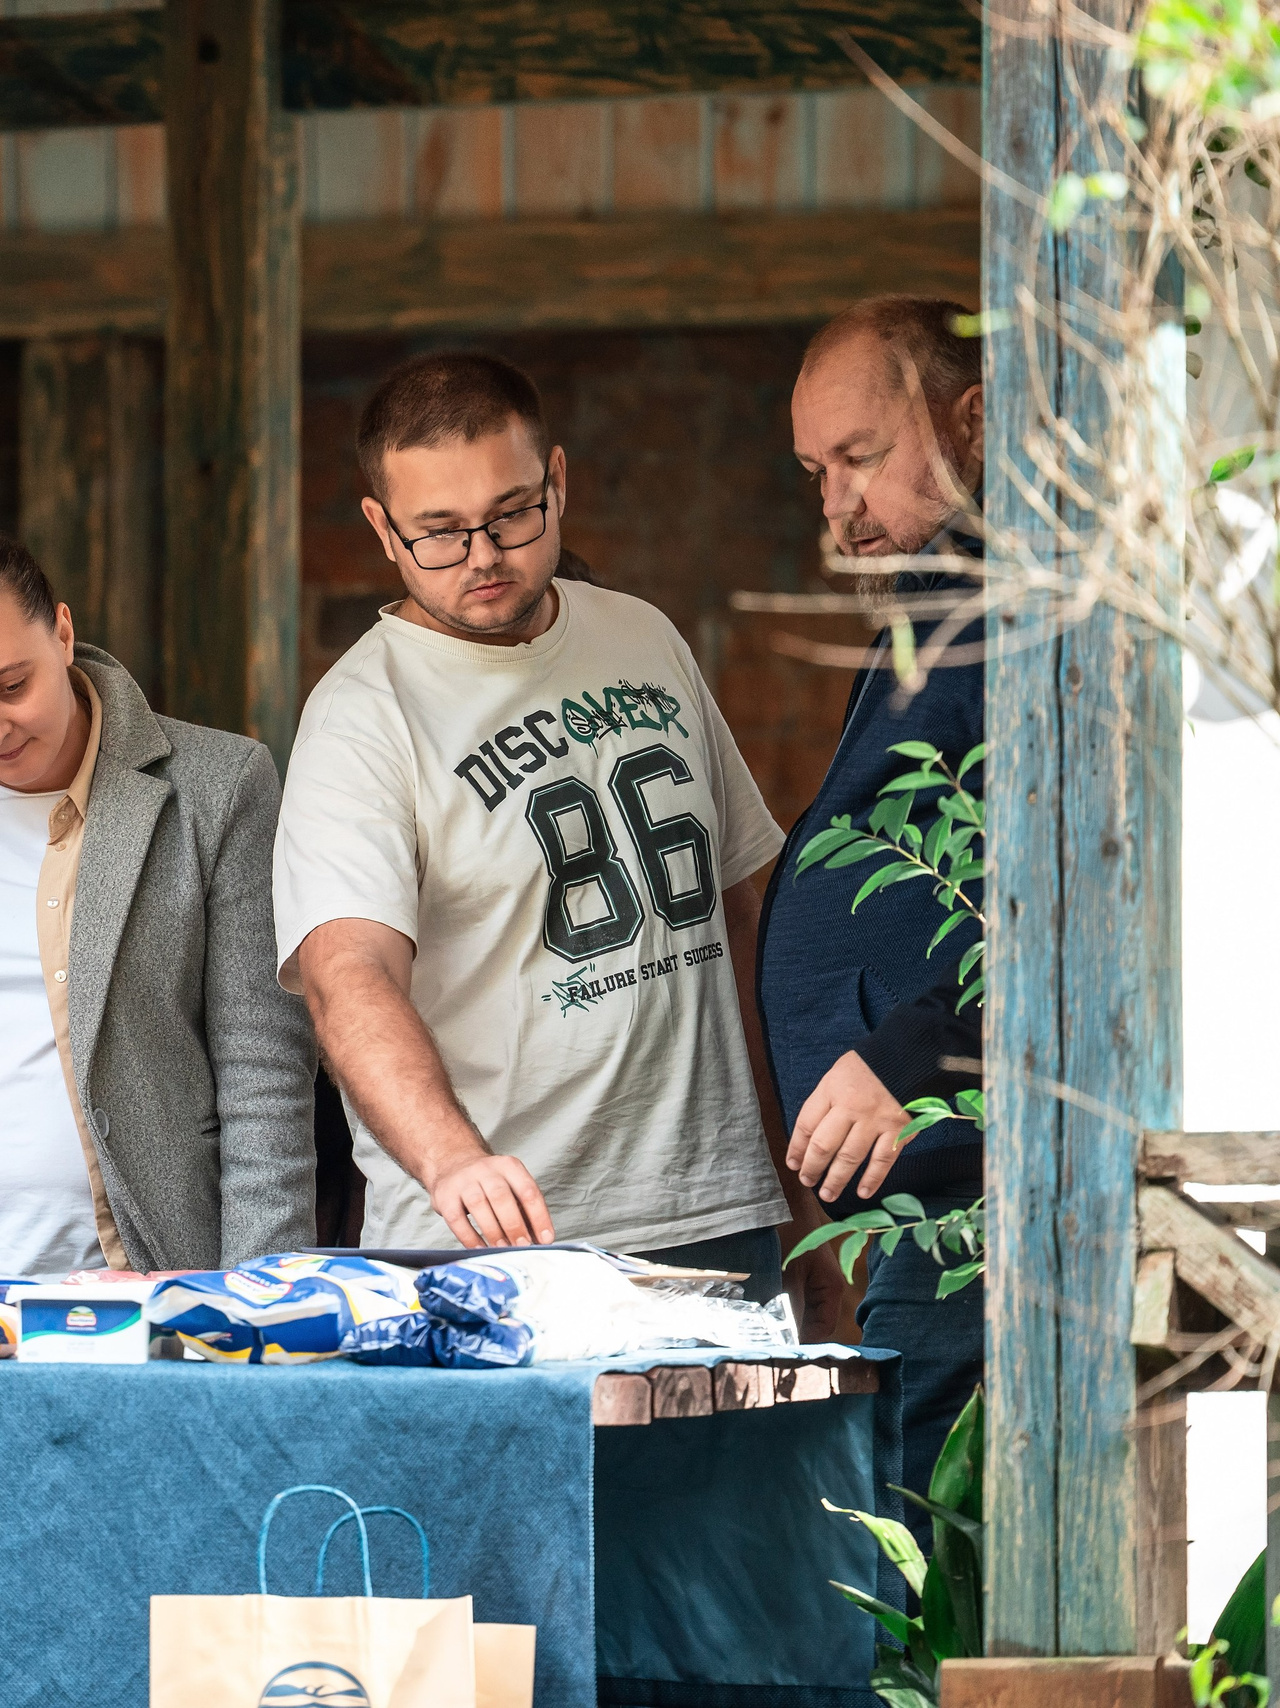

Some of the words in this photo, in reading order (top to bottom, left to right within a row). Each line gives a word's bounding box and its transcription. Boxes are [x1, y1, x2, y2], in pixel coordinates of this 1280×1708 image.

[453, 685, 690, 813] DISCOVER
[524, 742, 717, 964] 86
[567, 968, 638, 1003] FAILURE
[640, 955, 679, 981] START
[683, 941, 724, 967] SUCCESS
